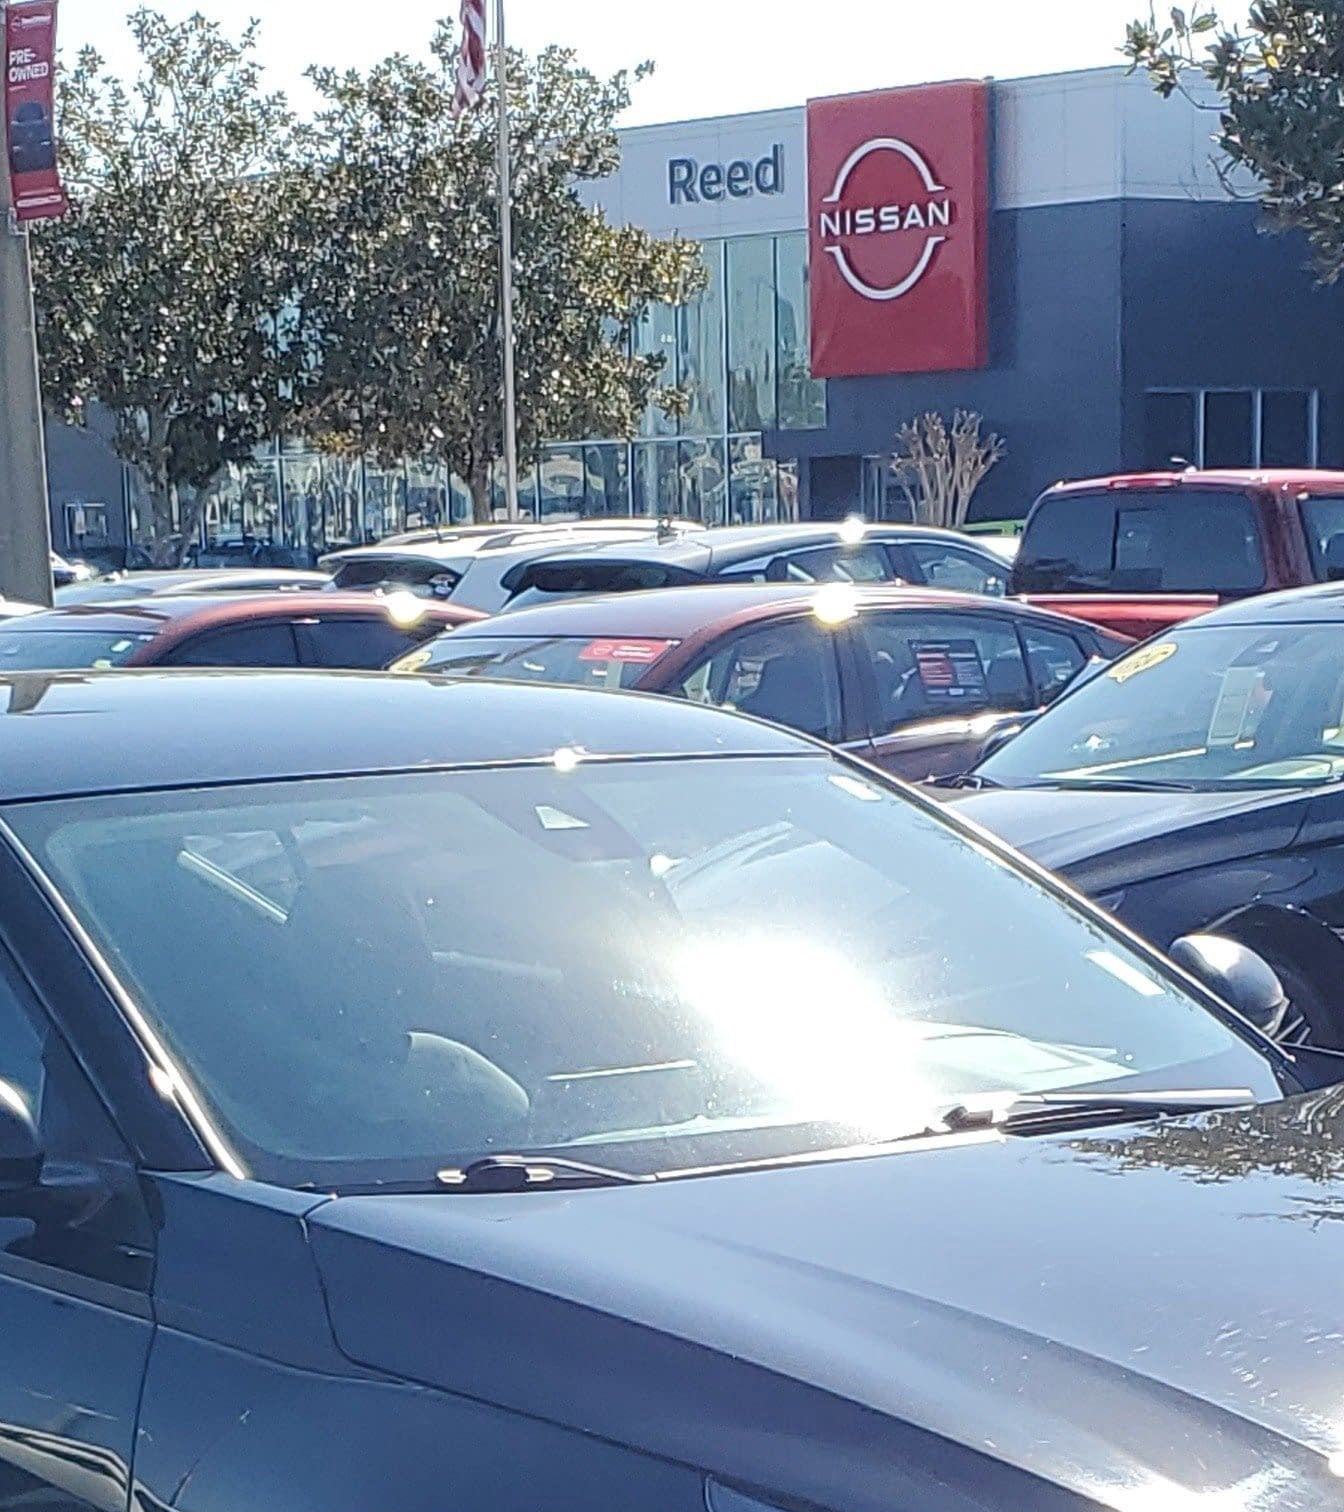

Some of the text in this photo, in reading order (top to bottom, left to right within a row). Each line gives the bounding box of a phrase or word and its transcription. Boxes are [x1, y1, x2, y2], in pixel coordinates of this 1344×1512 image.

[9, 48, 37, 66] PRE-
[8, 62, 49, 83] OWNED
[668, 144, 784, 204] Reed
[819, 199, 950, 238] NISSAN
